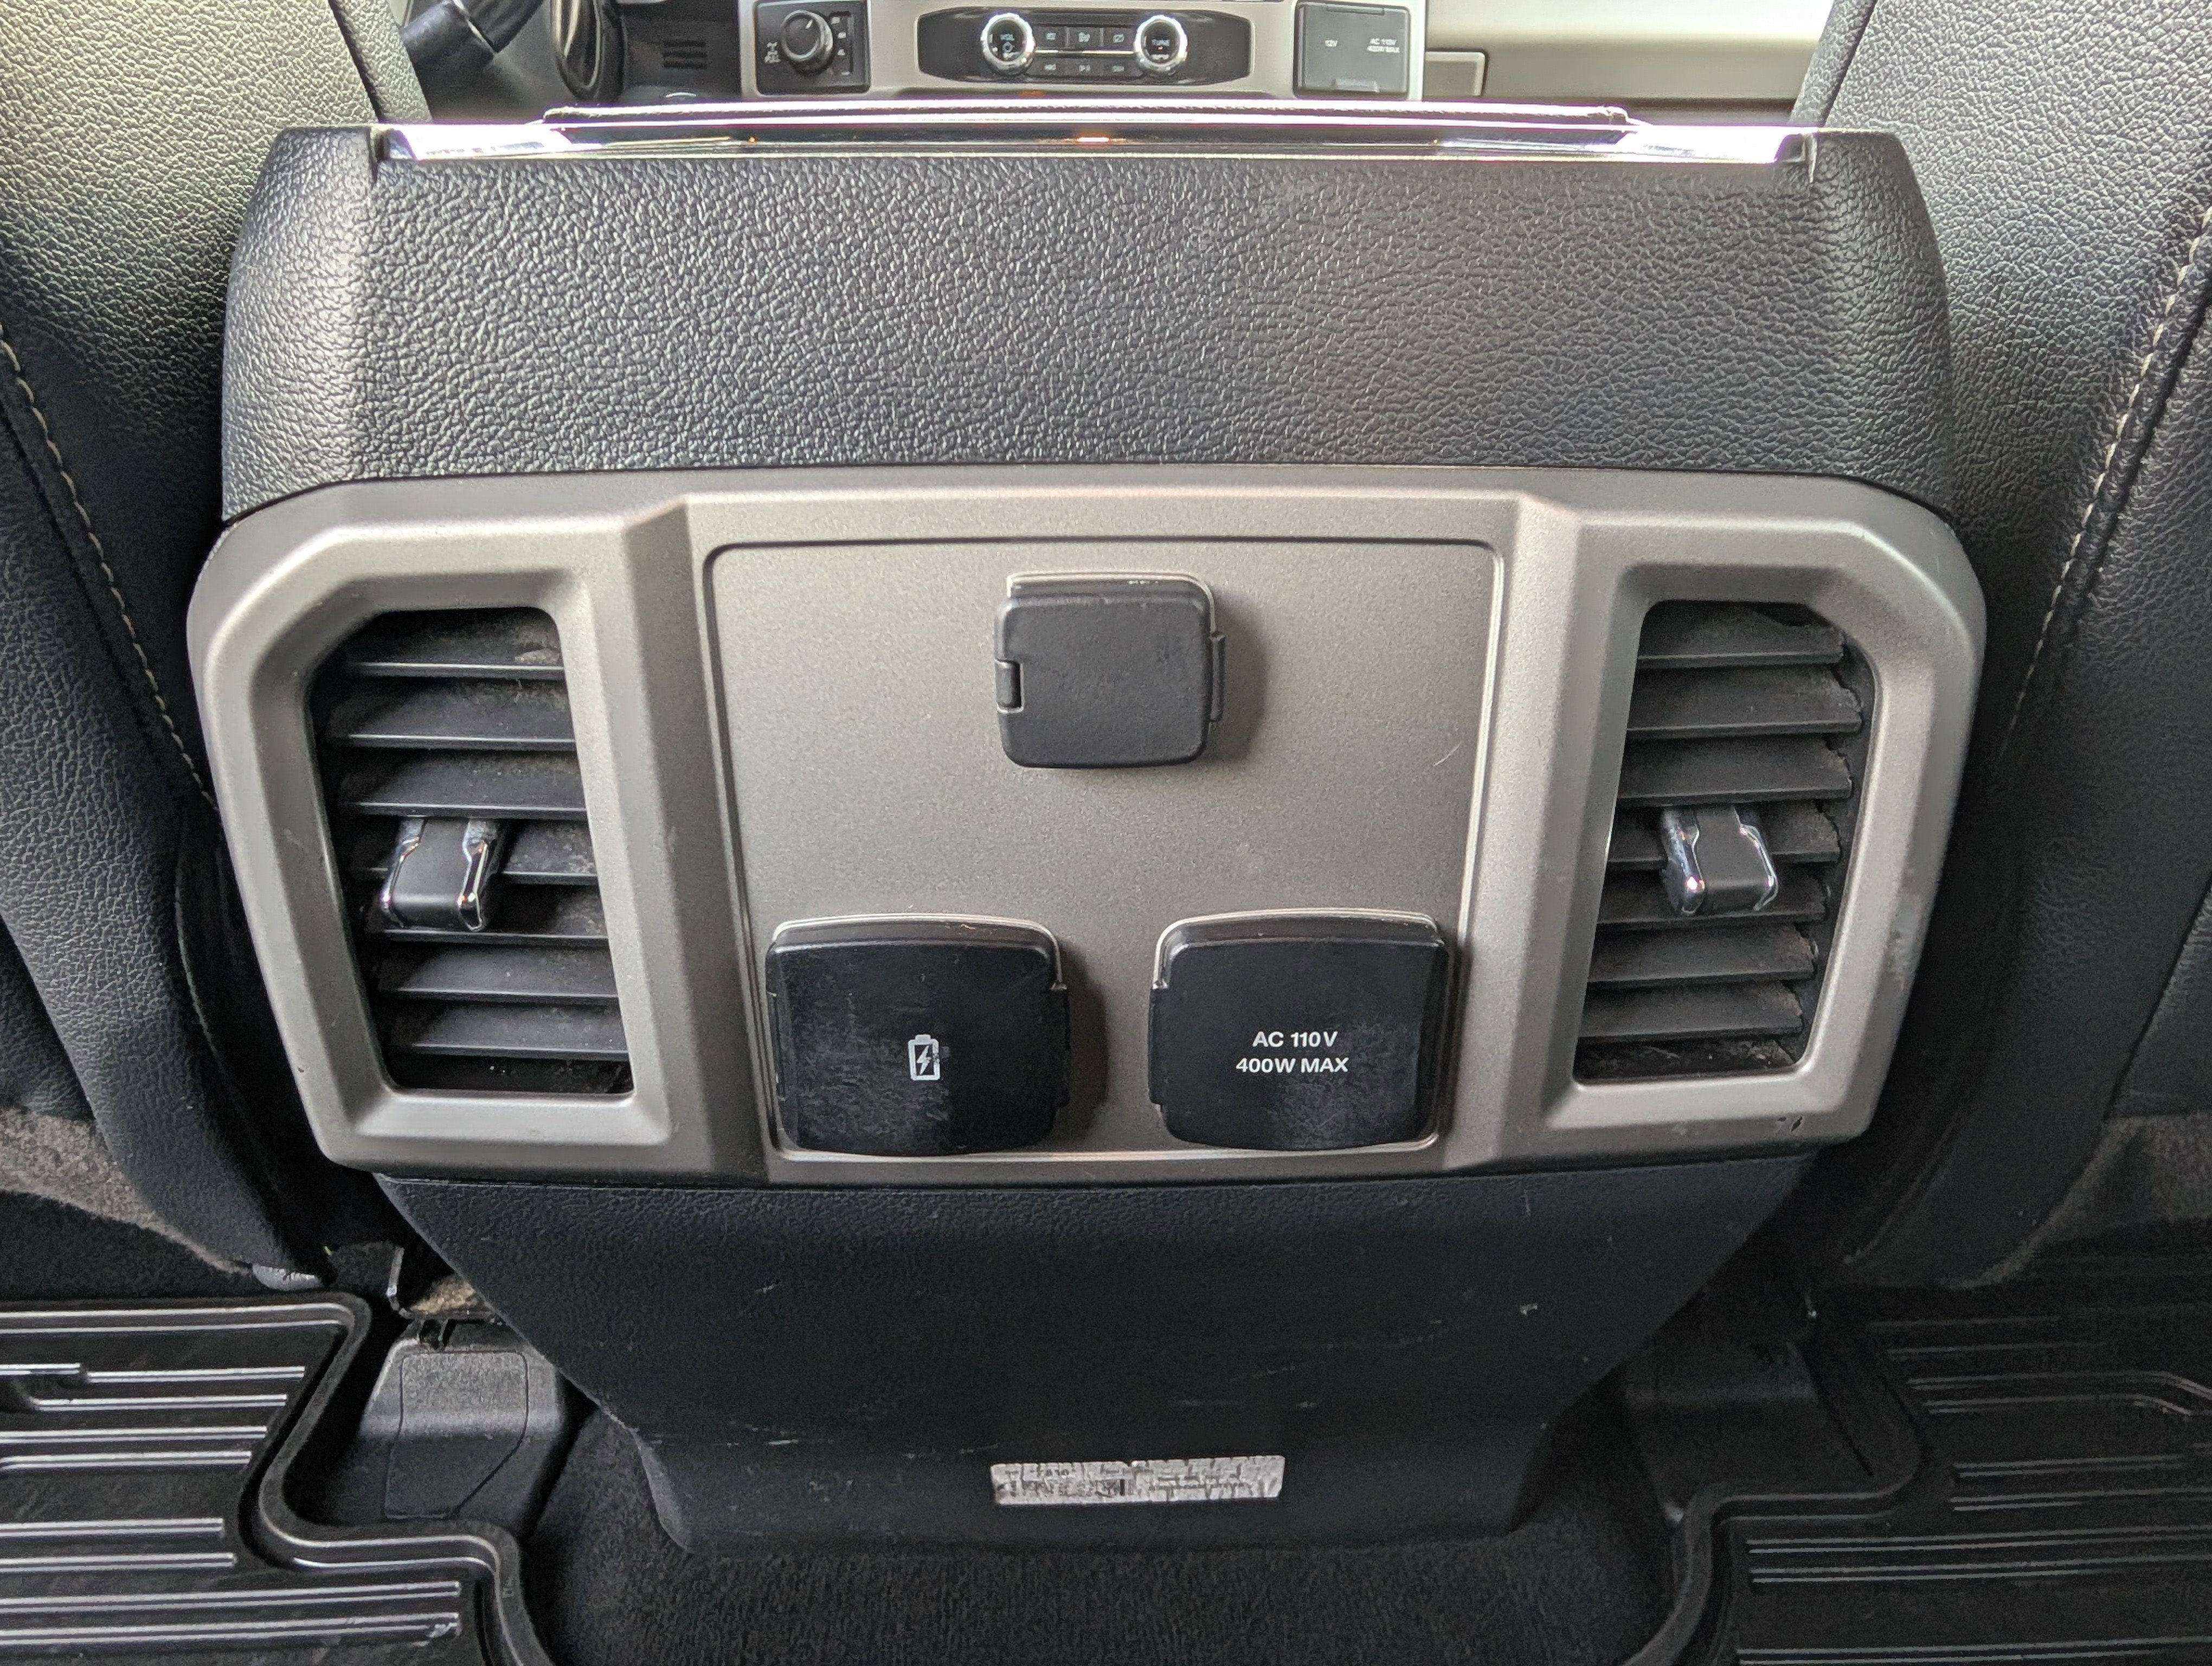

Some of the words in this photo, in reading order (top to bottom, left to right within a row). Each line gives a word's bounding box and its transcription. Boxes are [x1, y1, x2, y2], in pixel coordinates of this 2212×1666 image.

[1252, 1031, 1284, 1047] AC
[1235, 1057, 1296, 1073] 400W
[1301, 1057, 1349, 1073] MAX
